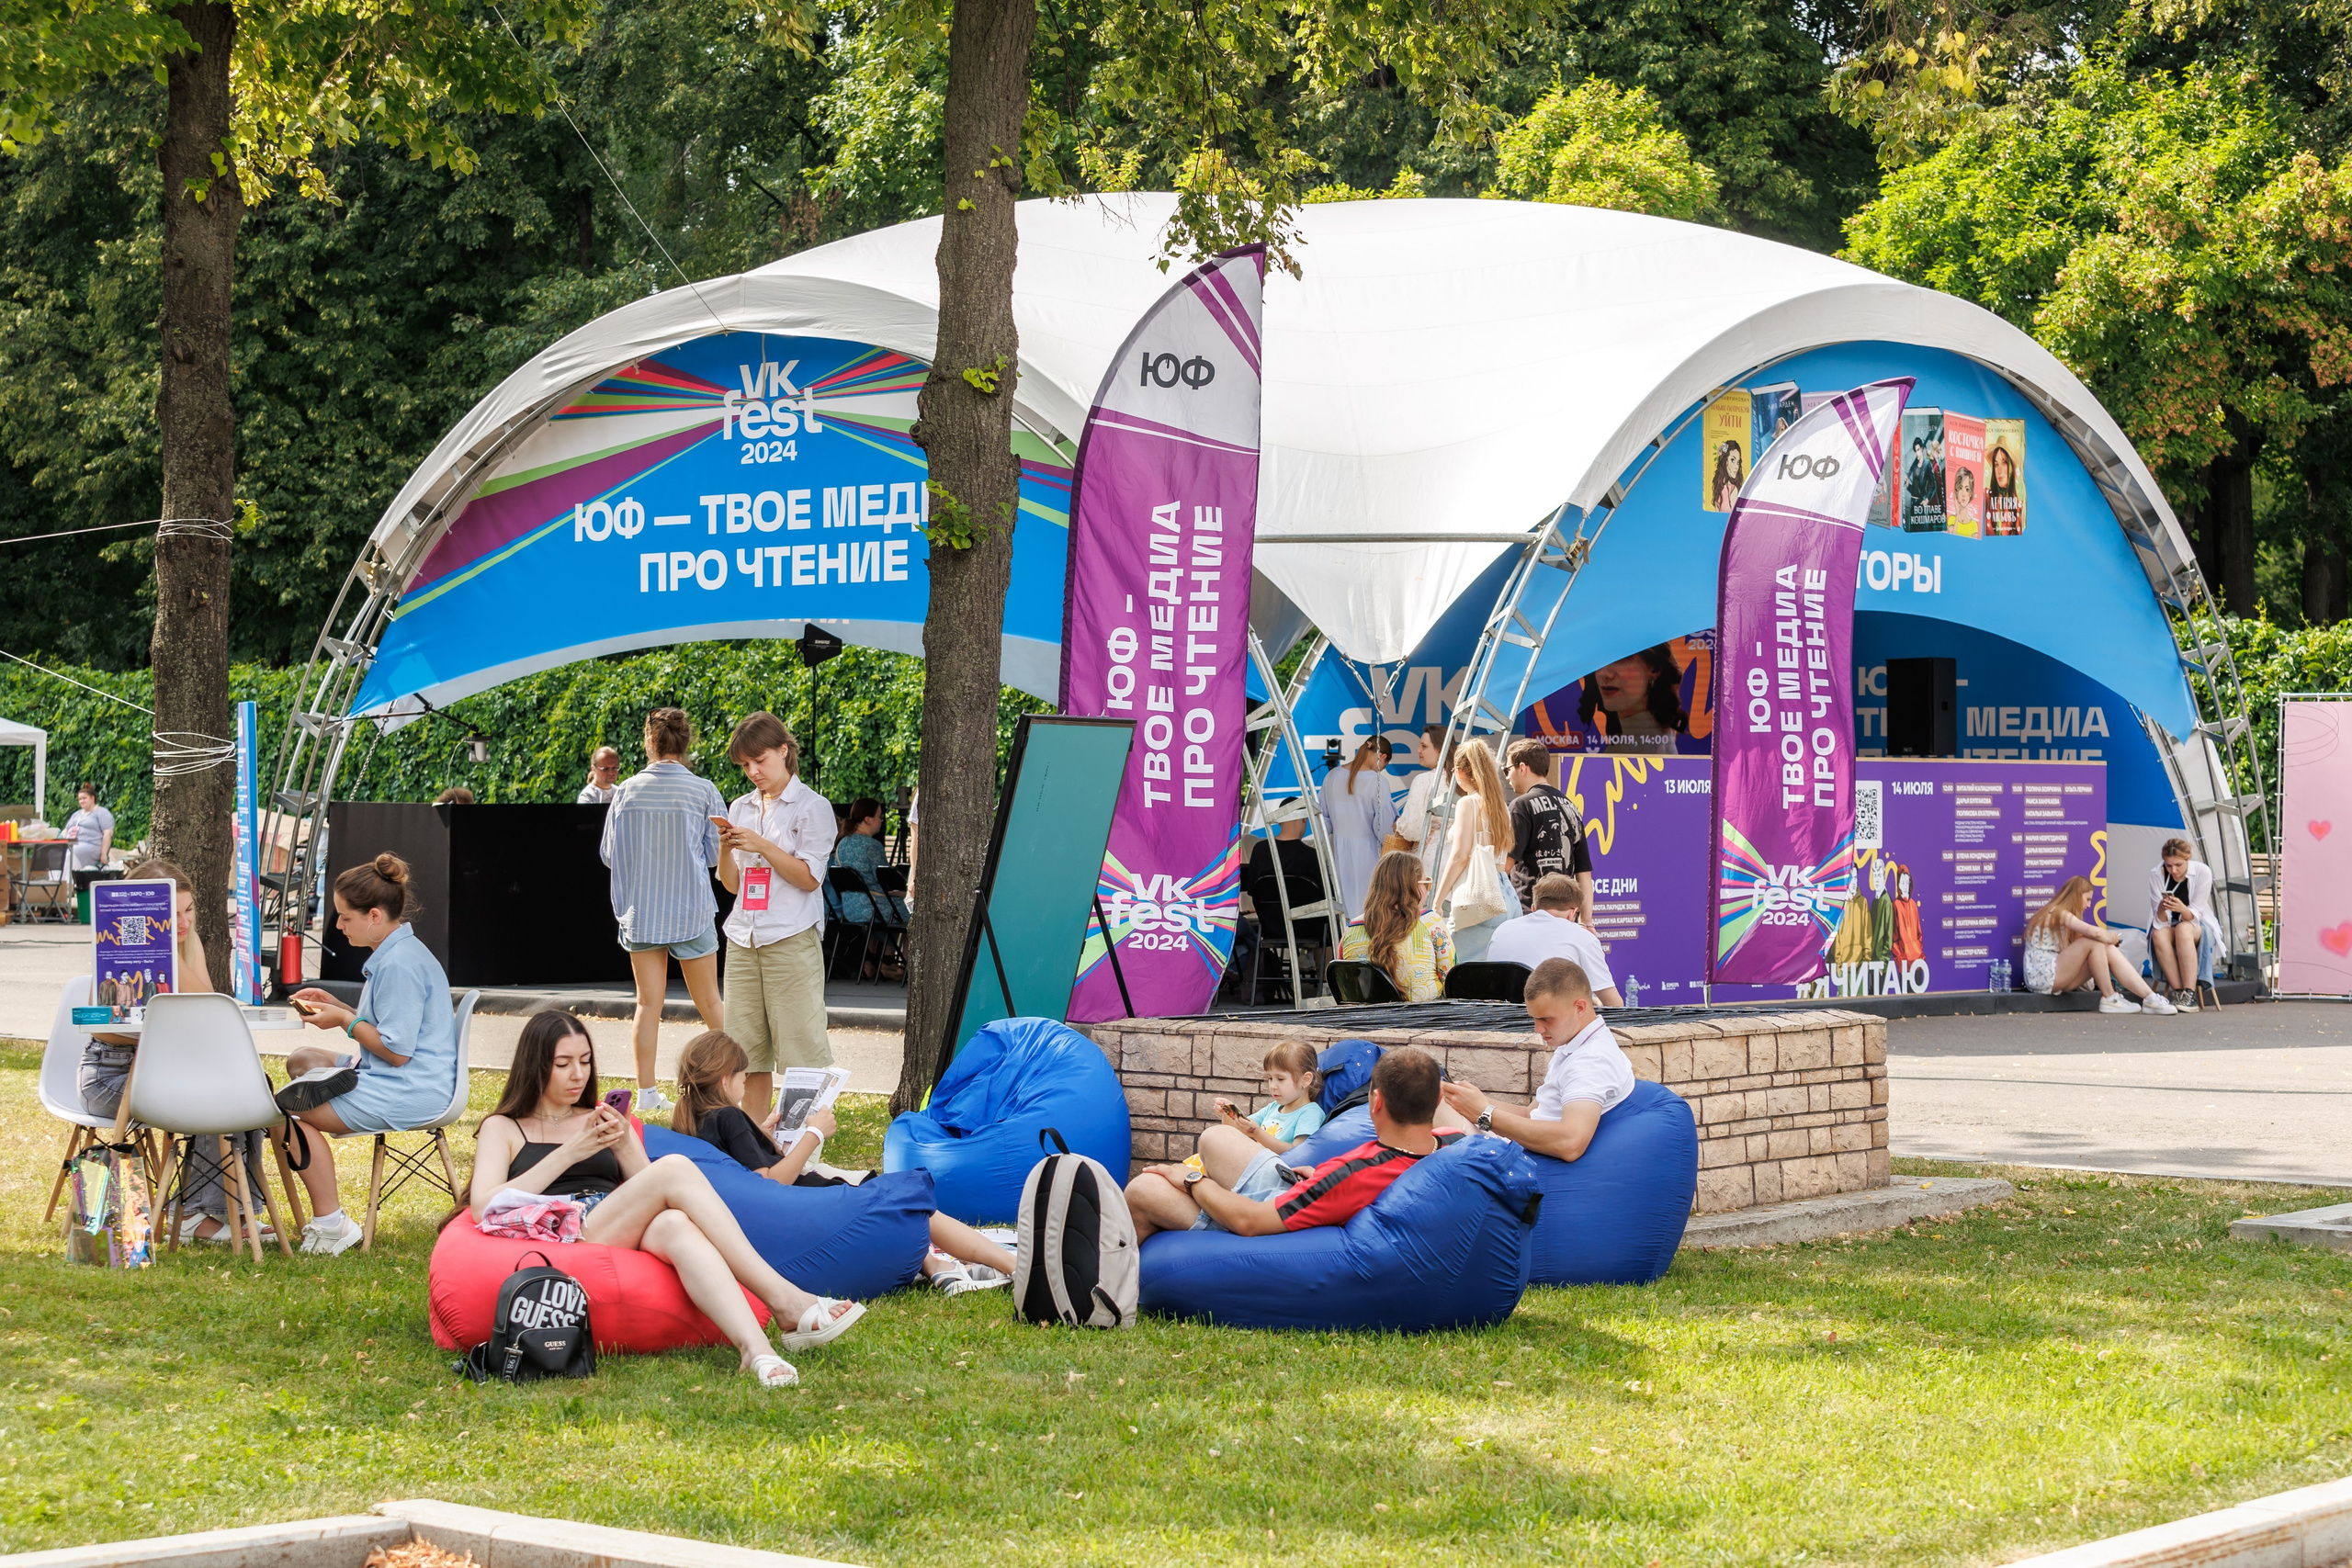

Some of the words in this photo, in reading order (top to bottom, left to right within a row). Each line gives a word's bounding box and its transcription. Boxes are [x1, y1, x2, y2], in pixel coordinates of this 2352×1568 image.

[739, 359, 800, 398] VK
[1140, 352, 1216, 389] ЮФ
[723, 390, 823, 441] fest
[1779, 400, 1794, 409] АРДЕН
[1719, 413, 1742, 428] УЙТИ
[741, 440, 797, 465] 2024
[1948, 430, 1984, 449] КОСТОЧКА
[1950, 446, 1955, 457] С
[1956, 447, 1982, 463] ВИШНЕЙ
[1777, 454, 1840, 481] ЮФ
[574, 496, 645, 543] ЮФ
[699, 490, 811, 536] ТВОЕ
[822, 482, 929, 534] МЕД
[1914, 506, 1922, 514] ВО
[1990, 497, 2017, 510] ЛЕТНЯЯ
[1911, 514, 1946, 525] КОШМАРОВ
[639, 550, 728, 592] ПРО
[736, 539, 909, 587] ЧТЕНИЕ
[1856, 550, 1940, 594] ТОРЫ
[1148, 501, 1183, 671] МЕДИА
[1185, 505, 1223, 695] ЧТЕНИЕ
[1688, 638, 1715, 650] 202
[1775, 564, 1803, 701] МЕДИА
[1805, 570, 1833, 714] ЧТЕНИЕ
[1107, 626, 1138, 710] ЮФ
[1747, 677, 1771, 733] ЮФ
[1966, 706, 2110, 744] МЕДИА
[1144, 685, 1175, 808] ТВОЕ
[1535, 736, 1579, 745] МОСКВА
[1587, 736, 1598, 745] 14
[1600, 736, 1638, 747] ИЮЛЯ,
[1641, 735, 1668, 745] 14:00
[1183, 707, 1216, 807] ПРО
[1781, 710, 1805, 808] ТВОЕ
[1812, 727, 1835, 807] ПРО
[1664, 780, 1674, 794] 13
[1677, 780, 1712, 794] ИЮЛЯ
[1892, 781, 1902, 795] 14
[1903, 781, 1934, 795] ИЮЛЯ
[1131, 874, 1194, 902] VK
[1611, 878, 1637, 897] ДНИ
[1767, 863, 1815, 887] VK
[1751, 882, 1831, 911] fest
[1110, 891, 1214, 933] fest
[1761, 912, 1810, 926] 2024
[1128, 933, 1189, 952] 2024
[510, 1296, 576, 1328] GUESS
[540, 1279, 588, 1316] LOVE
[544, 1340, 566, 1348] GUESS
